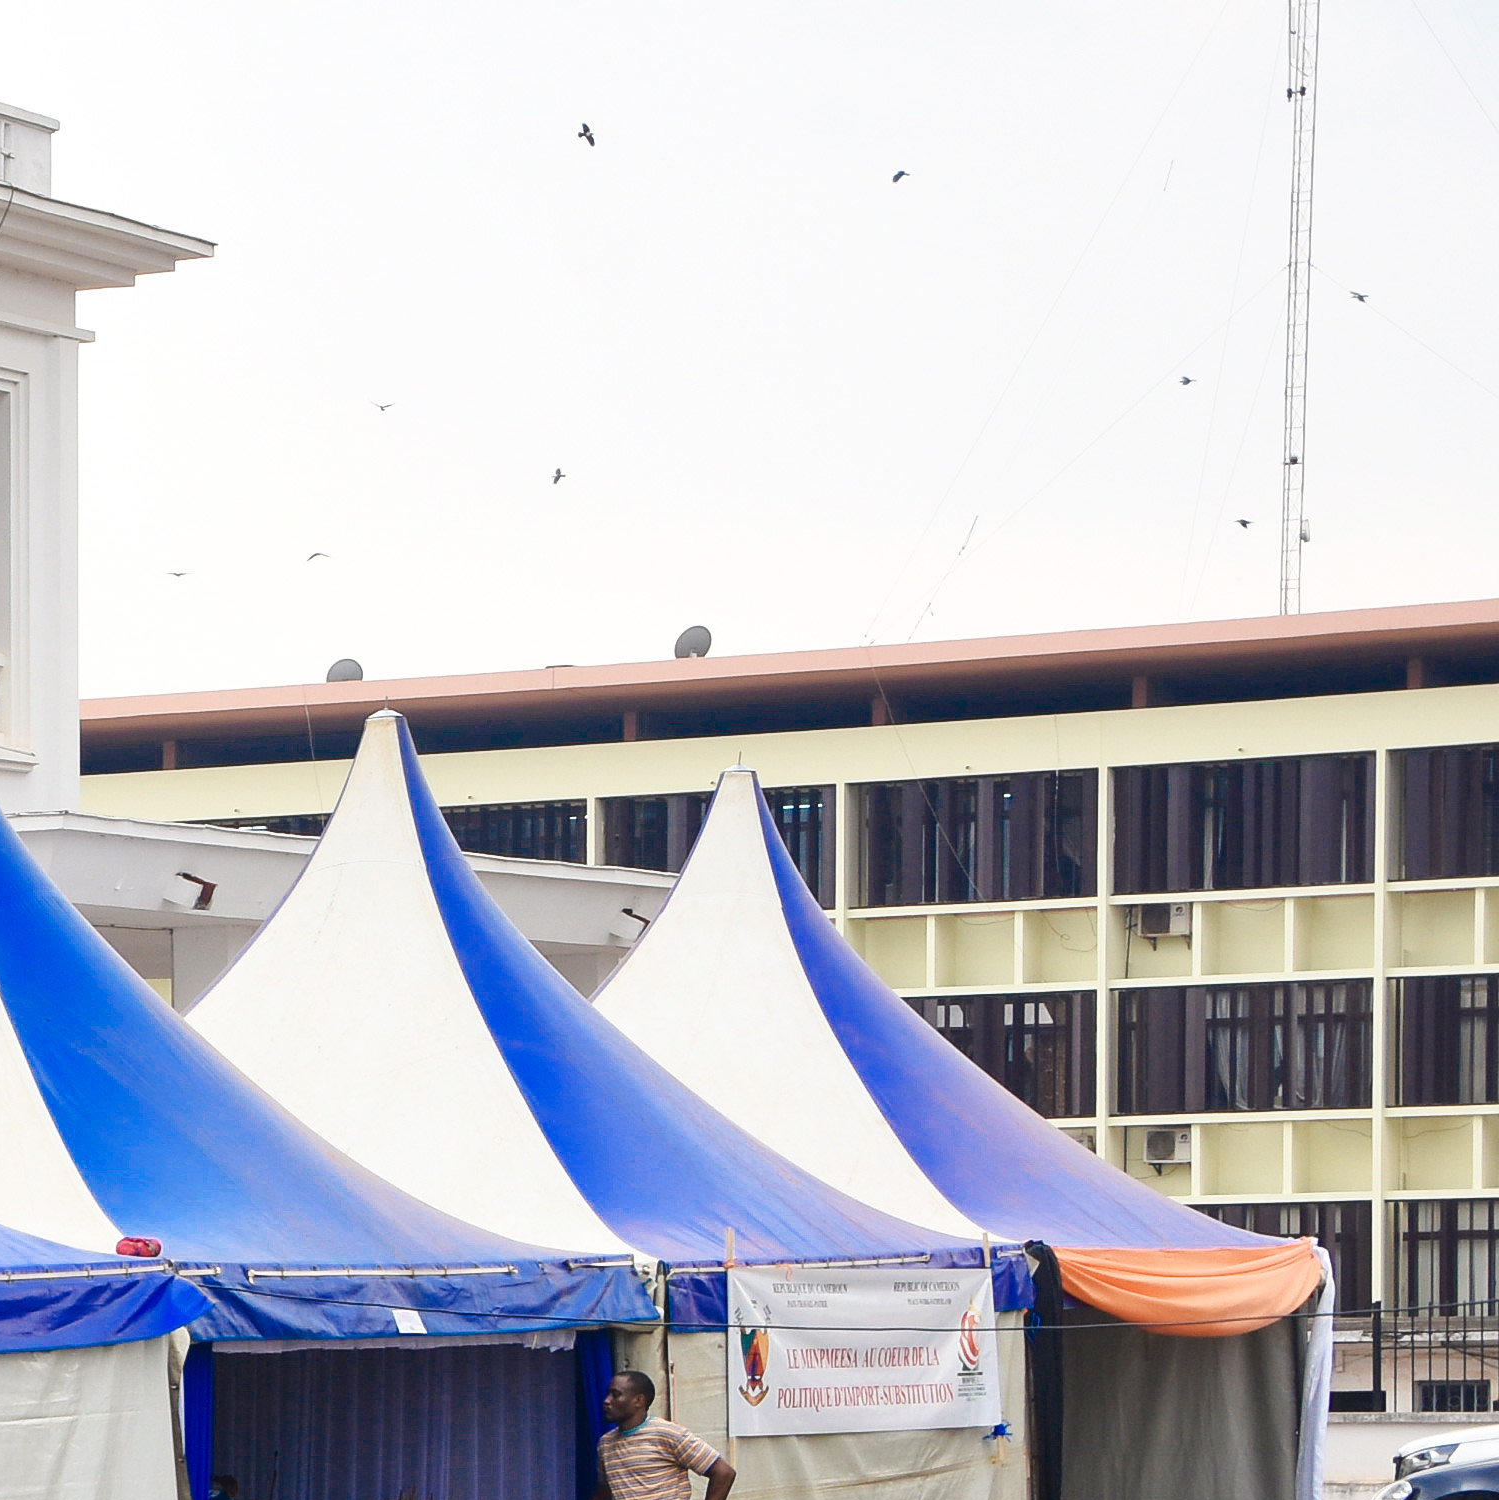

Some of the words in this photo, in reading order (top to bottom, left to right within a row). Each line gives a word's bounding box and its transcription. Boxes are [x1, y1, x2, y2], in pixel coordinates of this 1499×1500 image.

[787, 1349, 801, 1369] LE
[802, 1348, 859, 1369] MINPMEESA
[863, 1348, 877, 1368] AU
[877, 1346, 911, 1367] COEUR
[912, 1347, 927, 1366] DE
[927, 1346, 940, 1366] LA
[777, 1386, 833, 1412] POLITIQUE
[834, 1383, 954, 1408] D'IMPORT-SUBSTITUTION
